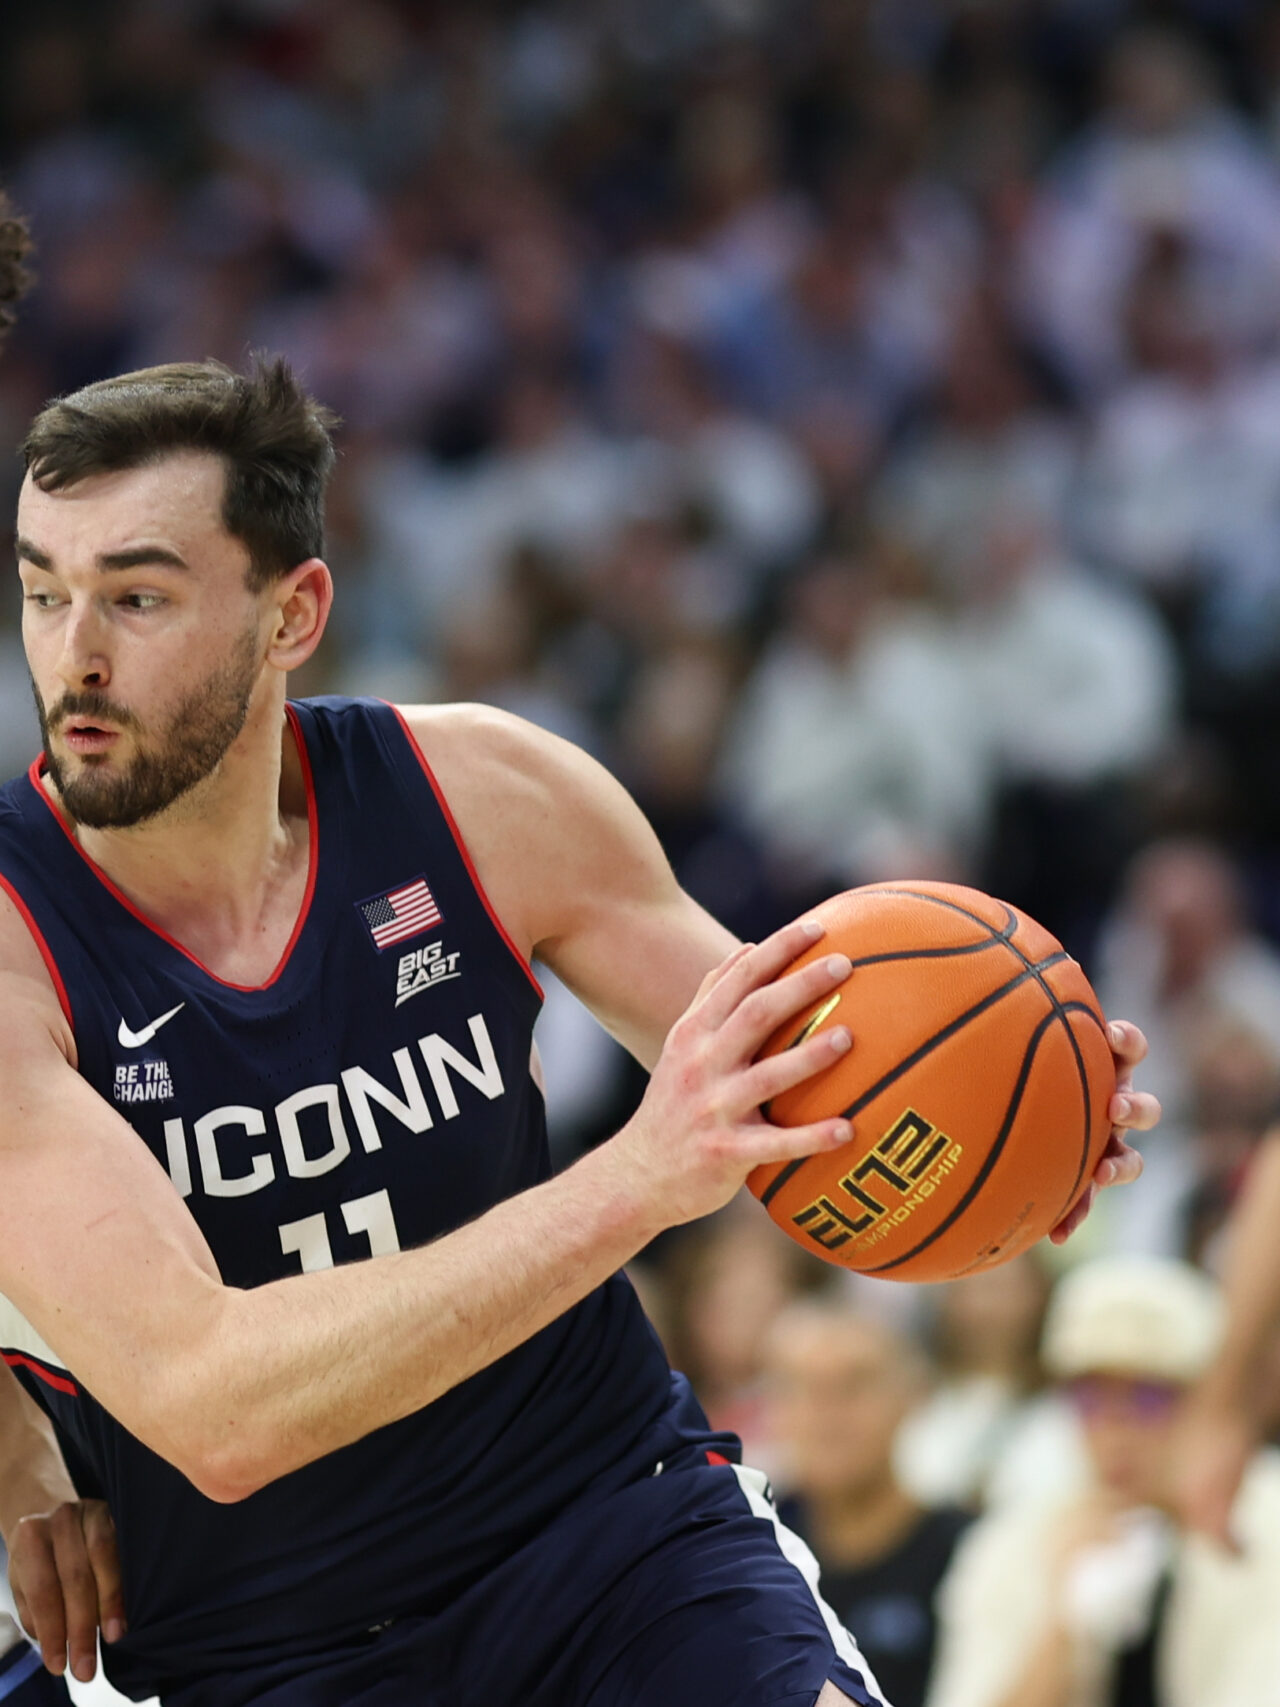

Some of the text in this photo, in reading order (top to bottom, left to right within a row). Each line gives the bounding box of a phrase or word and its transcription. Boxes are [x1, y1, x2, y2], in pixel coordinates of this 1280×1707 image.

[396, 952, 460, 996] EAST
[397, 940, 442, 977] BIG
[113, 1079, 175, 1102] CHANGE
[115, 1060, 170, 1084] BE THE
[790, 1106, 952, 1251] ELITE
